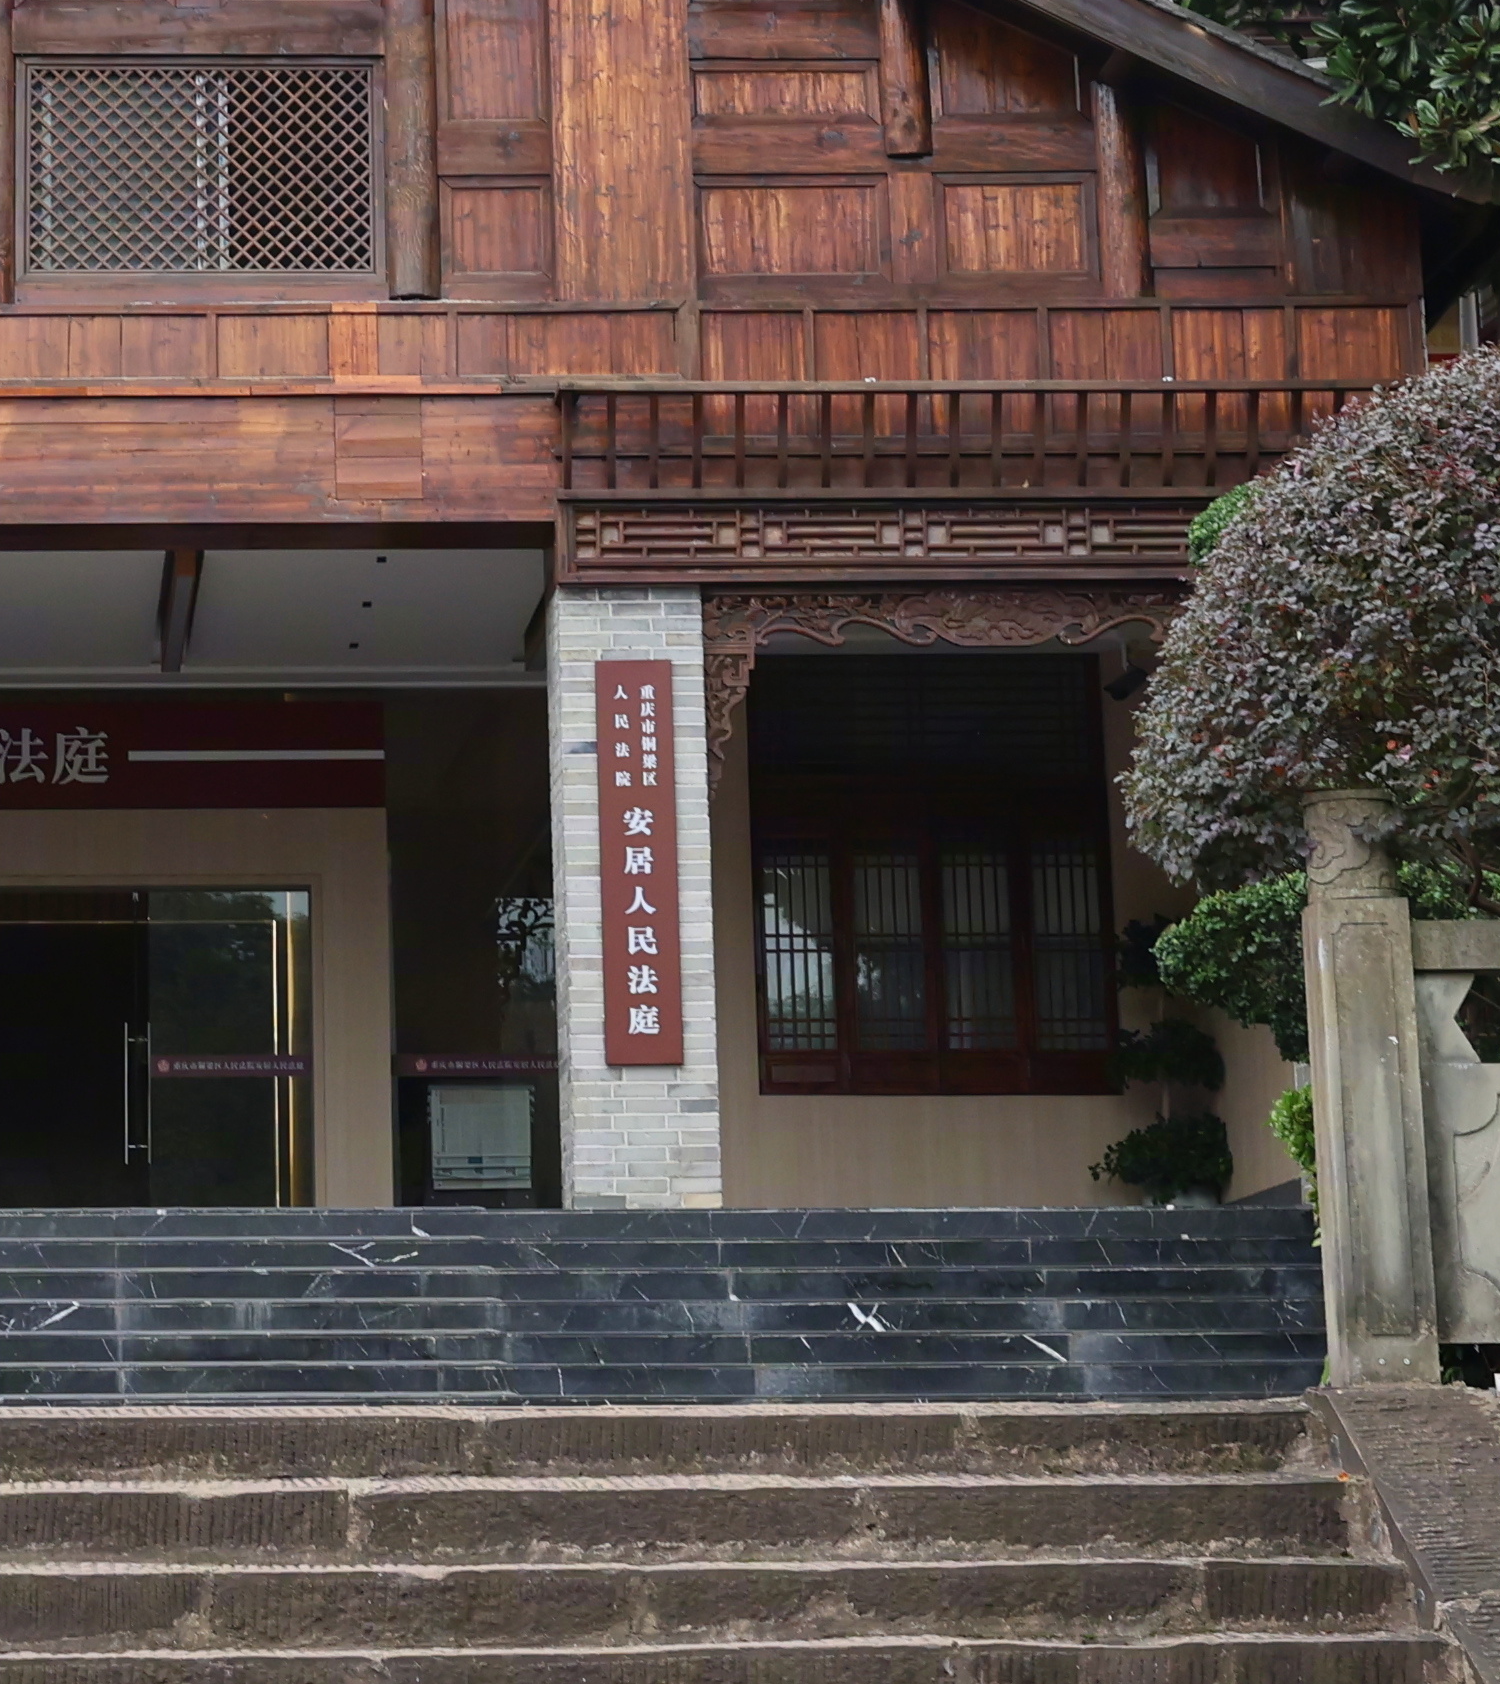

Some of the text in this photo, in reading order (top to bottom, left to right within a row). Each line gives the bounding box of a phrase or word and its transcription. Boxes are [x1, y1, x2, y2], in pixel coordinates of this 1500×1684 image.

[612, 684, 632, 787] 人民法院
[639, 684, 658, 787] 重庆市铜梁区
[622, 806, 661, 1035] 安居人民法庭
